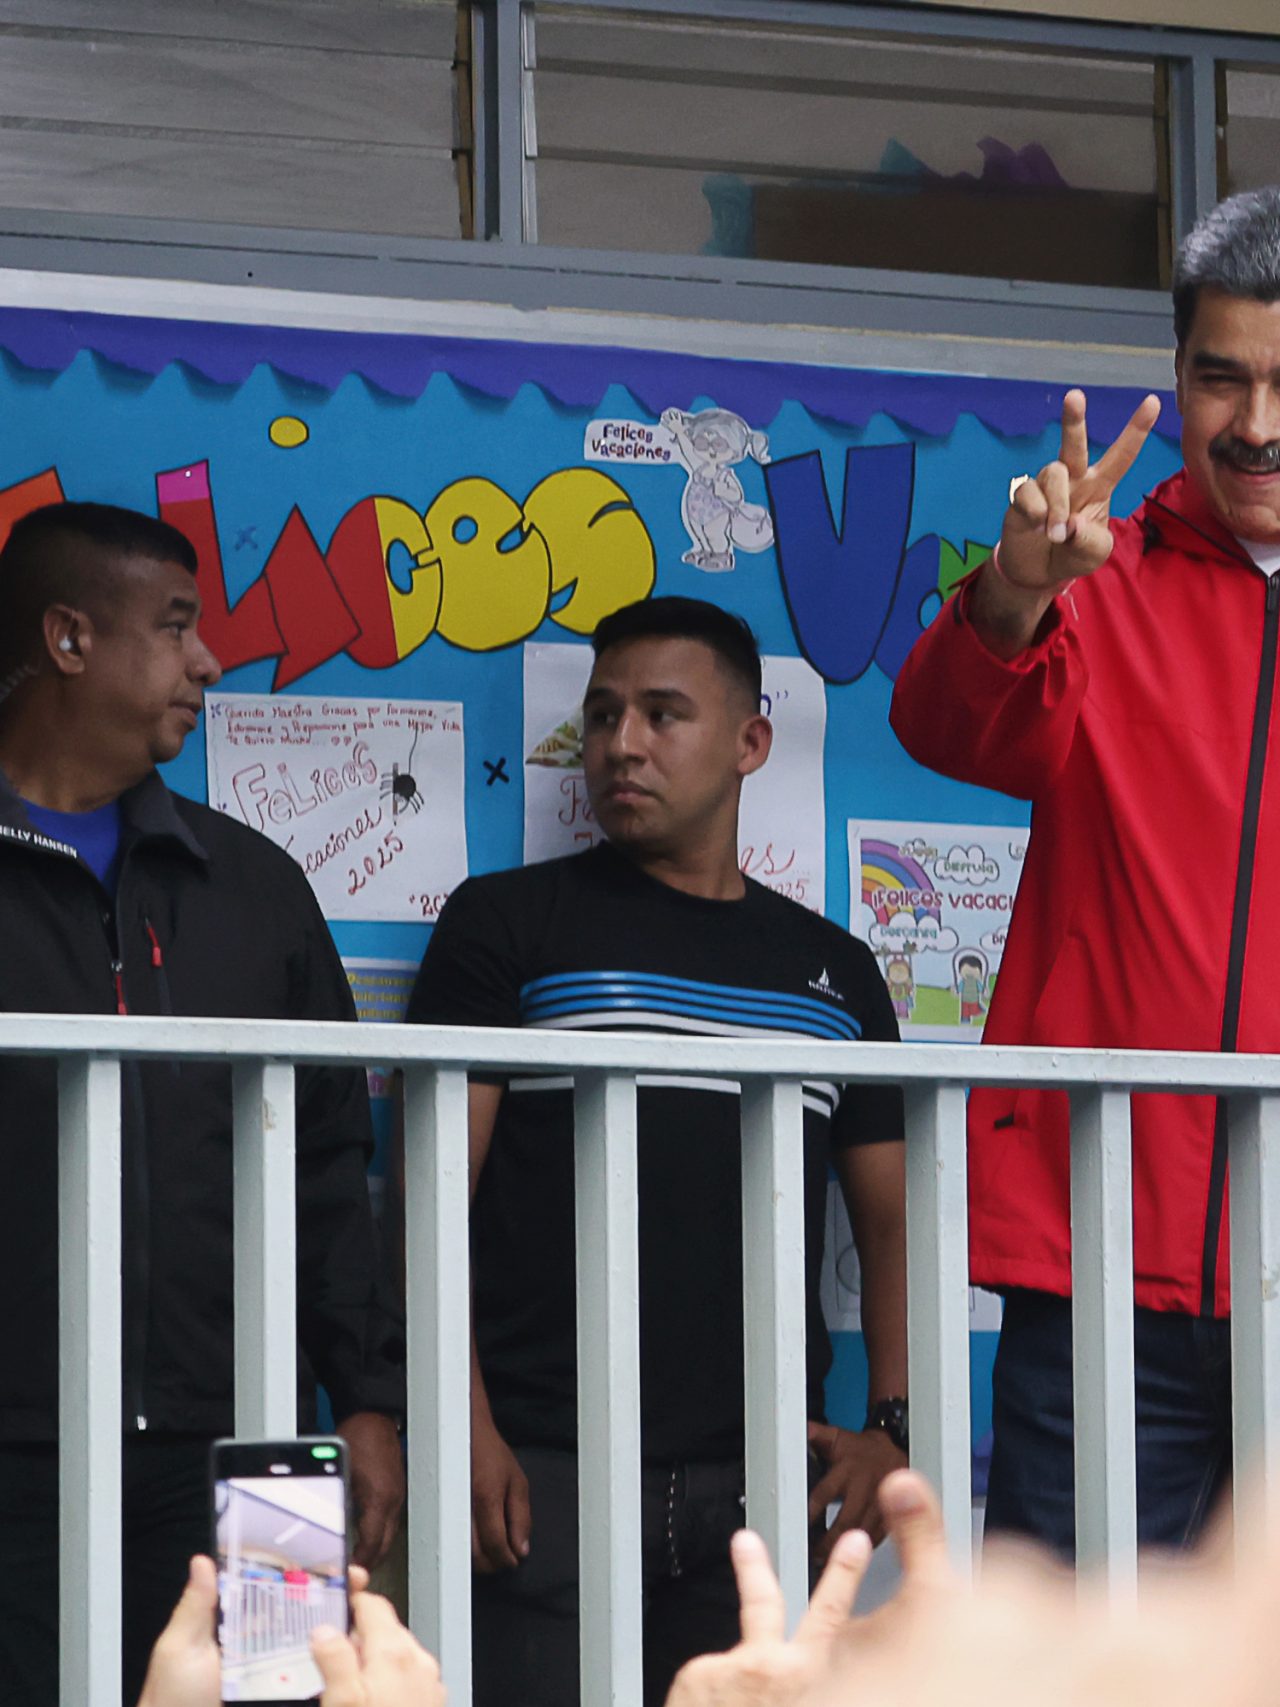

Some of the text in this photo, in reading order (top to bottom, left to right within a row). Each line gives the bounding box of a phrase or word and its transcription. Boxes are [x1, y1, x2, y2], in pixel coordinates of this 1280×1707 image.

[603, 422, 653, 443] Felices
[592, 438, 671, 460] Vacaciones
[33, 834, 77, 859] HANSEN
[348, 829, 404, 896] 2025
